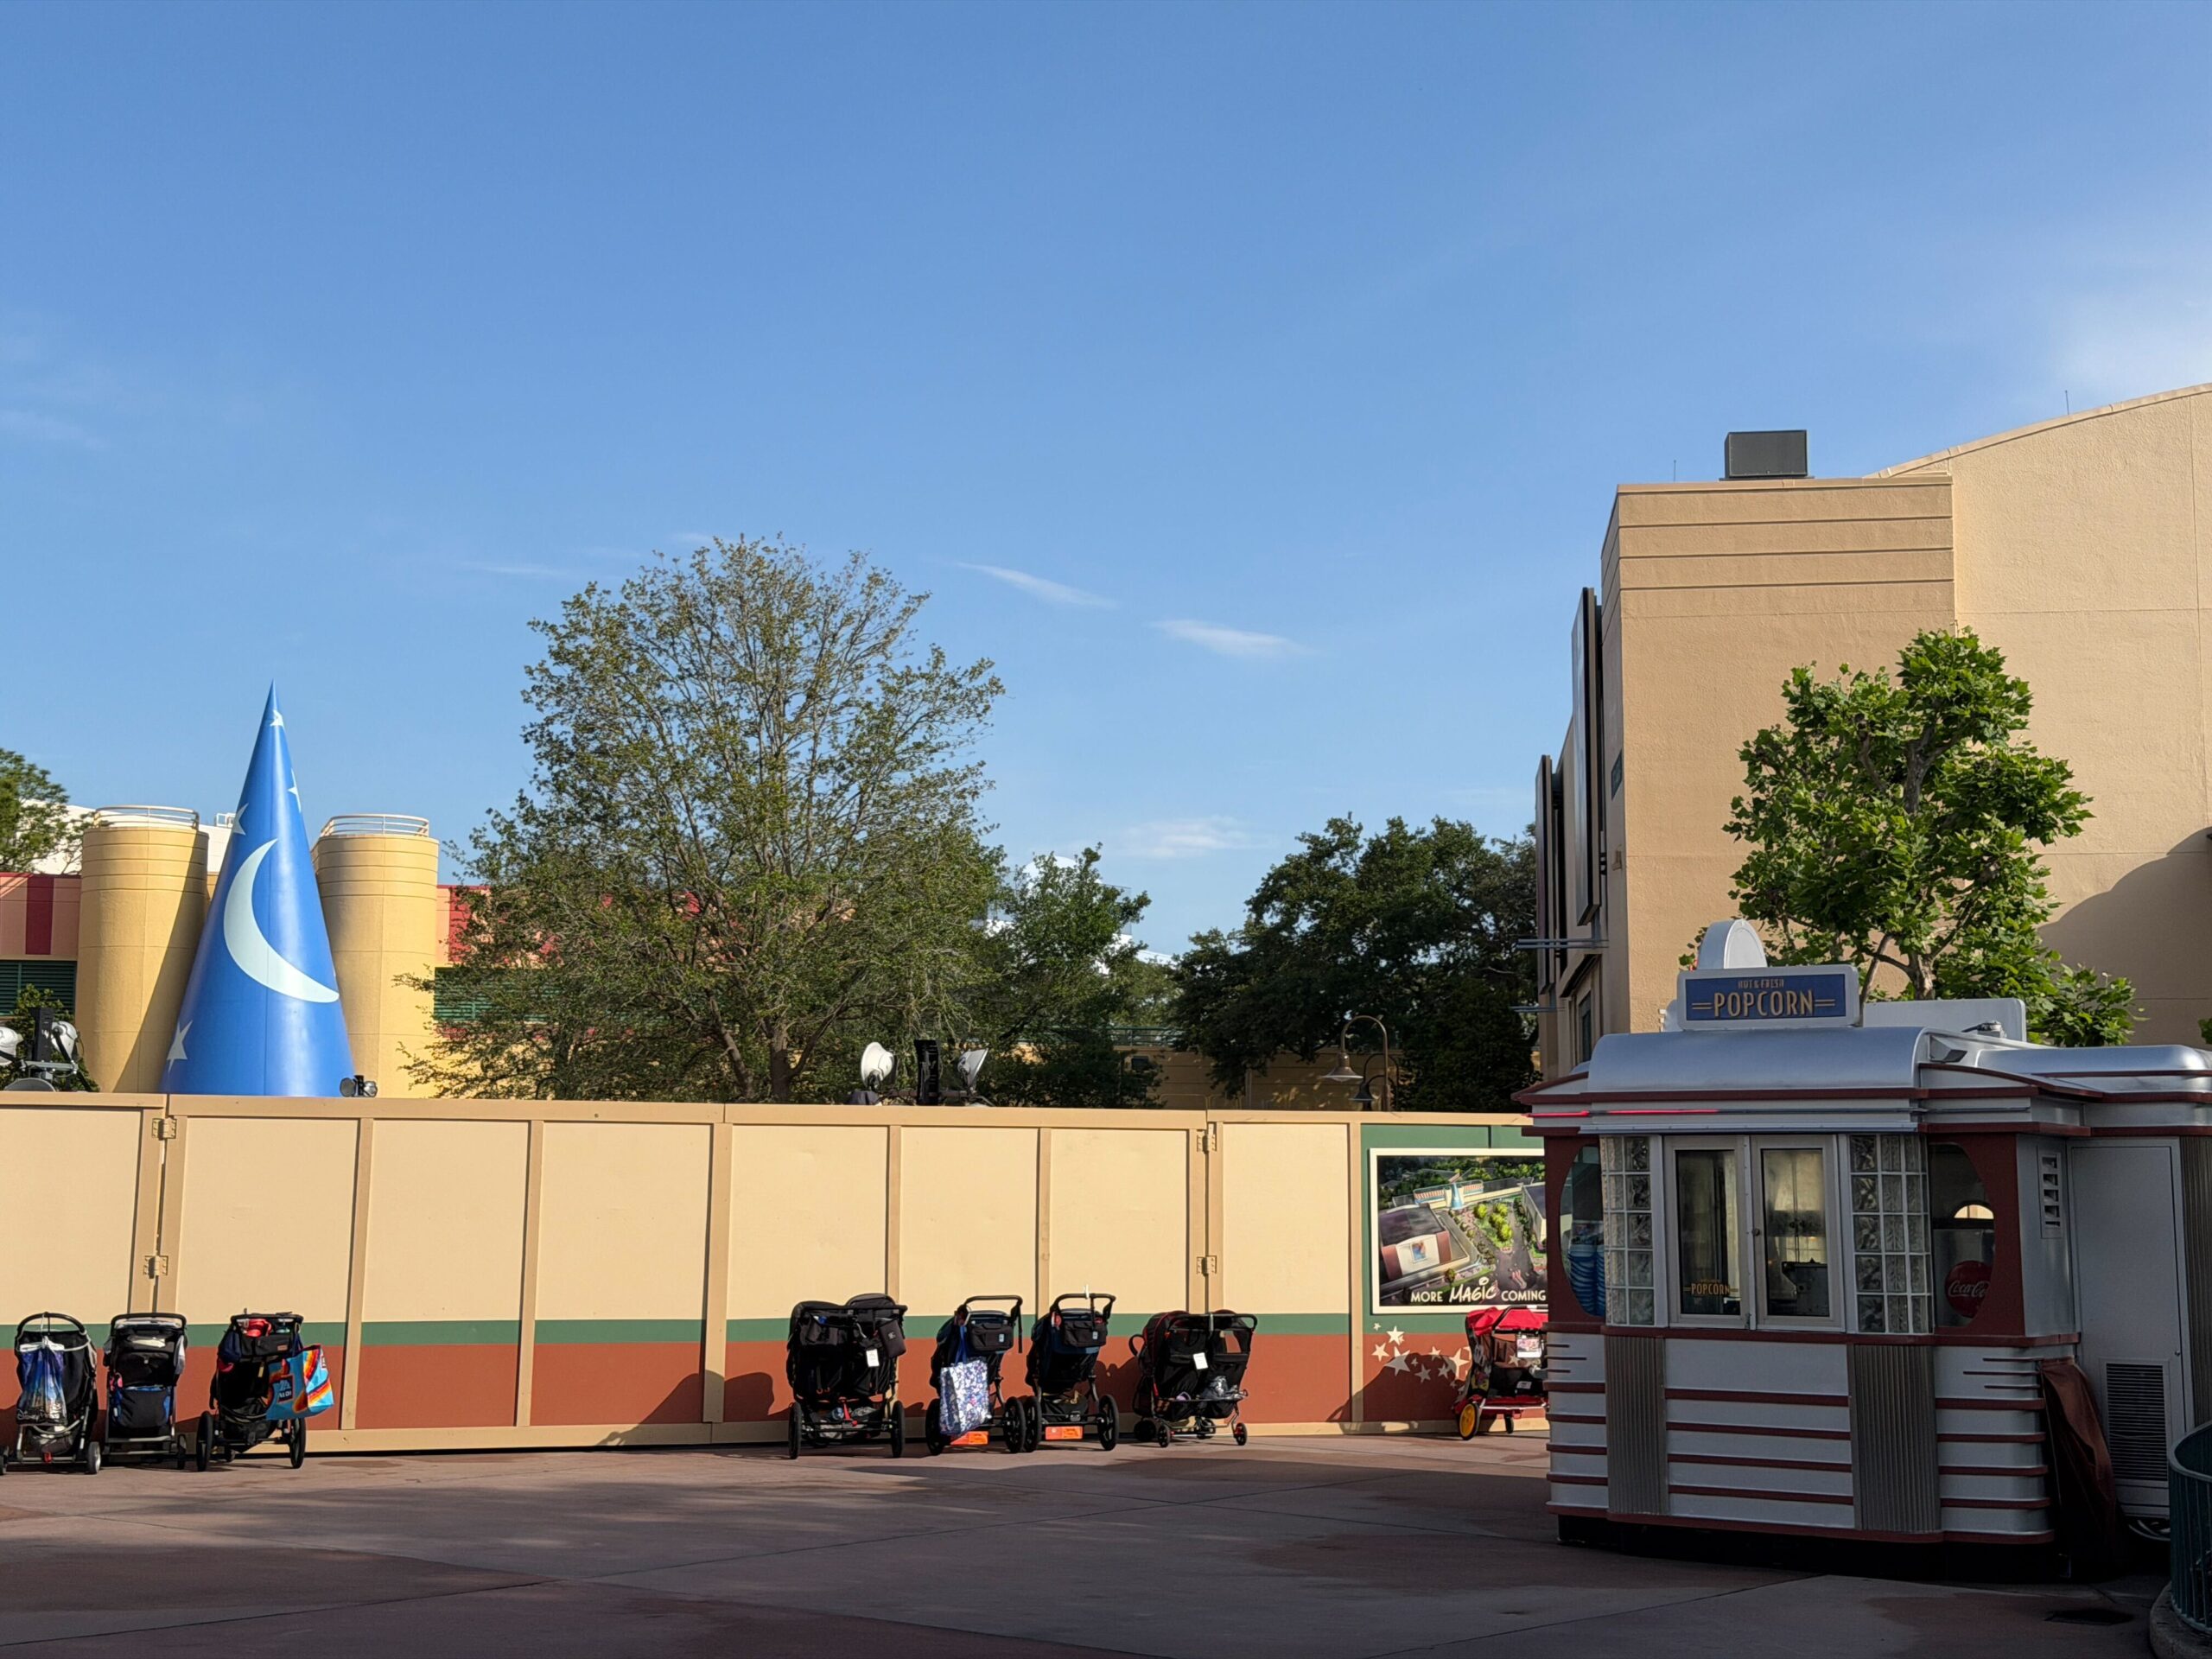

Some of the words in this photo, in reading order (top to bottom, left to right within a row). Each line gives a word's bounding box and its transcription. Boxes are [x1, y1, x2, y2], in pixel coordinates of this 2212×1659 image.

[1713, 989, 1814, 1017] POPCORN
[1410, 1291, 1443, 1303] MORE
[1501, 1289, 1546, 1301] COMING
[1691, 1283, 1730, 1295] POPCORN
